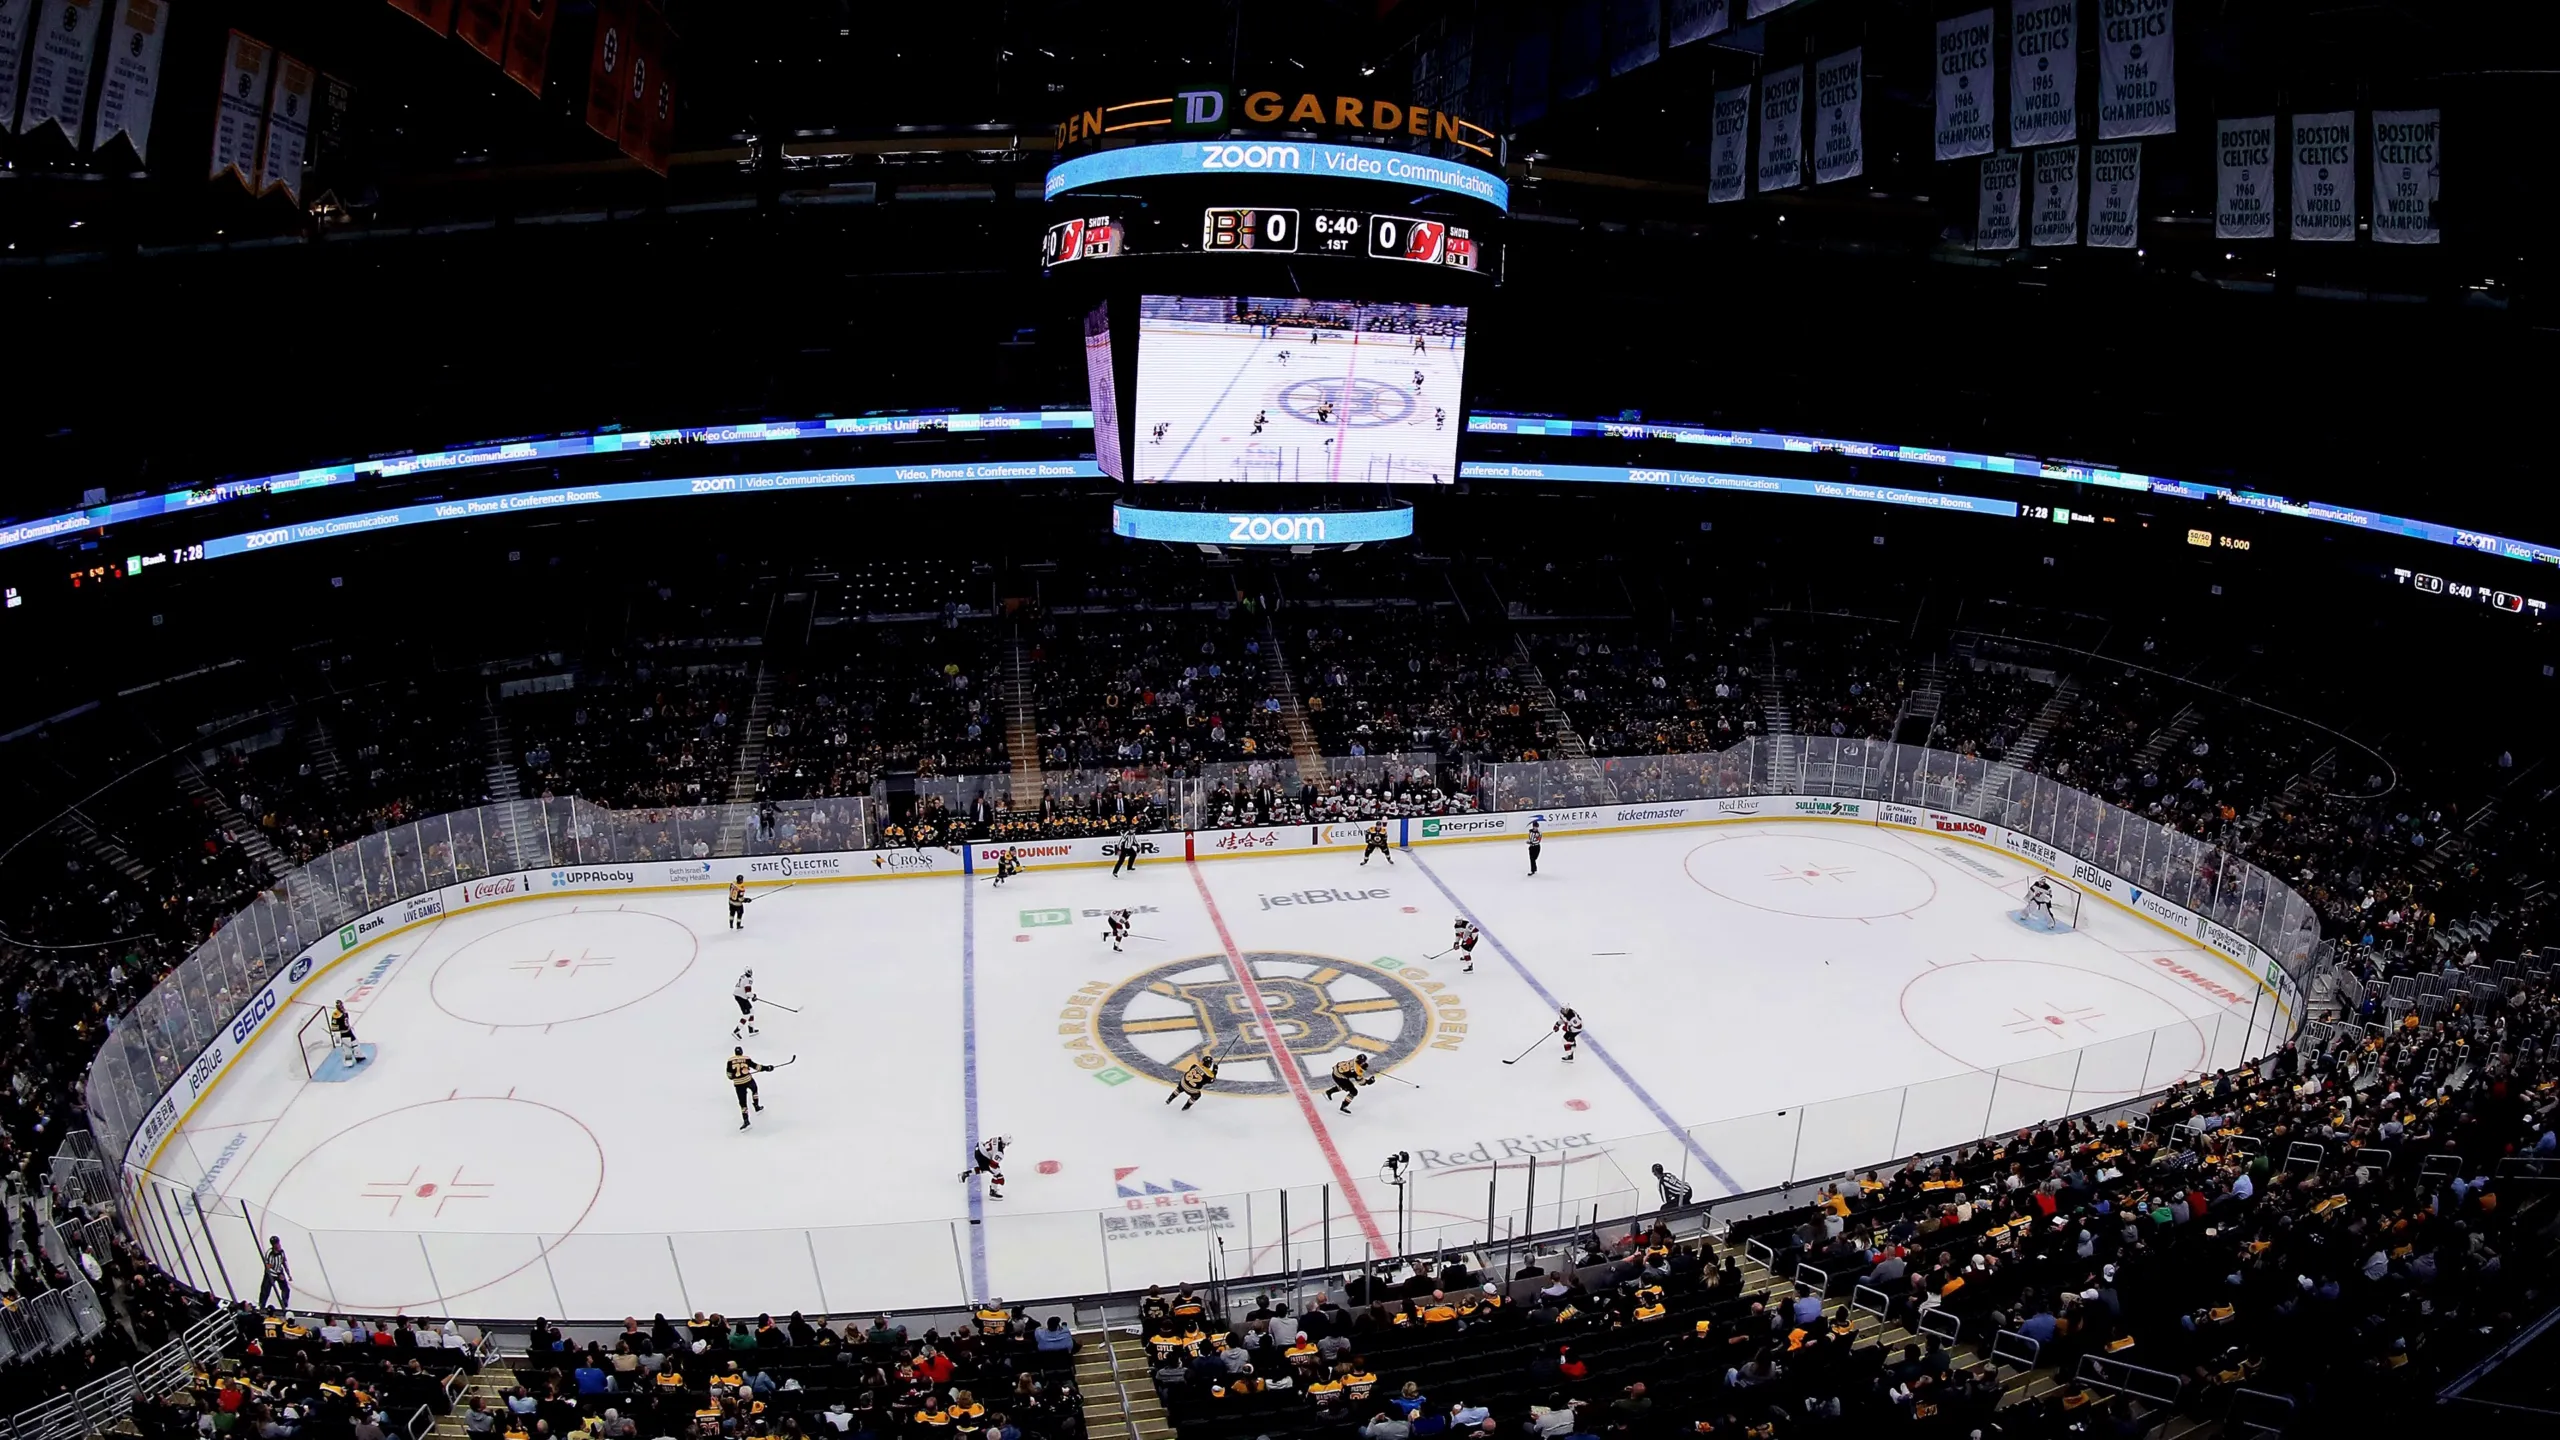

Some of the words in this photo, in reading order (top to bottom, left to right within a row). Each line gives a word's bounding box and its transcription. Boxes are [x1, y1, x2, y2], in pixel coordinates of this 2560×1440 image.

[2017, 3, 2071, 34] BOSTON
[2107, 12, 2166, 43] CELTICS
[1940, 25, 1989, 54] BOSTON
[2018, 28, 2069, 57] CELTICS
[1942, 47, 1987, 75] CELTICS
[1819, 61, 1858, 89] BOSTON
[2124, 64, 2148, 80] 1964
[1764, 79, 1799, 102] BOSTON
[2032, 76, 2053, 91] 1965
[2116, 81, 2157, 100] WORLD
[1820, 82, 1857, 108] CELTICS
[1954, 92, 1973, 105] 1966
[2025, 92, 2060, 111] WORLD
[1177, 90, 1224, 124] TD
[1244, 91, 1461, 144] GARDEN
[1765, 98, 1798, 121] CELTICS
[1949, 110, 1979, 126] WORLD
[2102, 99, 2170, 121] CHAMPIONS
[2014, 109, 2072, 132] CHAMPIONS
[1938, 124, 1991, 144] CHAMPIONS
[2221, 129, 2270, 148] BOSTON
[2297, 125, 2350, 146] BOSTON
[2378, 124, 2434, 143] BOSTON
[1826, 139, 1851, 153] WORLD
[2380, 145, 2432, 164] CELTICS
[1817, 152, 1858, 171] CHAMPIONS
[1983, 157, 2018, 174] BOSTON
[2037, 149, 2075, 167] BOSTON
[2095, 148, 2136, 165] BOSTON
[2223, 148, 2268, 167] CELTICS
[2299, 146, 2348, 166] CELTICS
[1202, 145, 1299, 170] zoom
[1325, 152, 1382, 174] Video
[1386, 157, 1495, 198] Communications
[2038, 167, 2073, 183] CELTICS
[2096, 165, 2135, 182] CELTICS
[1984, 174, 2016, 190] CELTICS
[2236, 183, 2255, 197] 1960
[2313, 183, 2334, 196] 1959
[2397, 183, 2418, 196] 1957
[2229, 198, 2260, 211] WORLD
[2307, 198, 2340, 212] WORLD
[2389, 199, 2424, 213] WORLD
[1088, 216, 1110, 228] SHOTS
[1314, 216, 1359, 235] 6:40
[2042, 210, 2066, 222] WORLD
[2100, 210, 2126, 223] WORLD
[2219, 212, 2270, 227] CHAMPIONS
[2295, 214, 2351, 229] CHAMPIONS
[1266, 215, 1286, 242] 0
[1379, 222, 1396, 249] 0
[1450, 226, 1469, 240] SHOTS
[1050, 231, 1057, 257] 0
[1326, 240, 1348, 251] 1ST
[721, 427, 801, 441] Communications
[457, 446, 538, 467] Communications
[691, 477, 736, 493] zoom
[745, 474, 776, 489] Video
[777, 471, 855, 486] Communications
[895, 470, 928, 482] Video,
[931, 468, 964, 480] Phone
[966, 467, 975, 478] &
[977, 466, 1037, 477] Conference
[1039, 464, 1077, 475] Rooms.
[1511, 466, 1545, 479] Rooms.
[1629, 470, 1671, 483] zoom
[1679, 473, 1703, 485] Video
[1705, 475, 1780, 491] Communications
[436, 505, 467, 520] Video,
[468, 500, 499, 516] Phone
[500, 499, 509, 511] &
[510, 493, 565, 510] Conference
[566, 490, 602, 505] Rooms.
[1814, 483, 1844, 499] Video,
[1845, 486, 1875, 501] Phone
[1876, 490, 1885, 501] &
[1886, 491, 1939, 508] Conference
[1940, 496, 1975, 511] Rooms.
[2022, 505, 2048, 520] 7:28
[2071, 512, 2095, 524] Bank
[20, 515, 91, 542] Communications
[246, 529, 289, 548] zoom
[297, 524, 325, 540] Video
[326, 513, 400, 536] Communications
[1228, 516, 1325, 541] zoom
[2190, 532, 2210, 544] 50/50
[2219, 536, 2250, 552] $5,000
[142, 554, 166, 567] Bank
[173, 545, 203, 564] 7:28
[2430, 578, 2438, 591] 0
[2448, 582, 2472, 599] 6:40
[2496, 593, 2504, 606] 0
[1617, 808, 1685, 821] ticketmaster
[1718, 801, 1735, 811] Red
[1736, 800, 1760, 810] River
[1795, 801, 1832, 811] SULLIVAN
[1842, 803, 1860, 813] TIRE
[1548, 811, 1598, 821] SYMETRA
[1880, 811, 1894, 822] LIVE
[1895, 813, 1917, 826] GAMES
[1018, 845, 1072, 858] DUNKIN'
[669, 868, 683, 878] Beth
[684, 866, 702, 876] Israel
[751, 862, 780, 872] STATE
[793, 859, 839, 870] ELECTRIC
[566, 870, 635, 886] UPPAbaby
[670, 875, 689, 886] Lahey
[690, 873, 711, 883] Health
[2072, 861, 2113, 892] jetBlue
[1258, 887, 1390, 912] jetBlue
[403, 909, 418, 923] LIVE
[418, 902, 442, 919] GAMES
[2142, 897, 2189, 928] vistaprint
[358, 915, 385, 934] Bank
[2152, 957, 2254, 1005] DUNKIN'
[232, 988, 276, 1045] GEICO
[1398, 966, 1469, 1052] GARDEN
[1058, 980, 1112, 1069] GARDEN
[187, 1048, 223, 1099] jetBlue
[1414, 1141, 1495, 1170] Red
[1500, 1132, 1594, 1158] River
[1108, 1233, 1140, 1243] ORG
